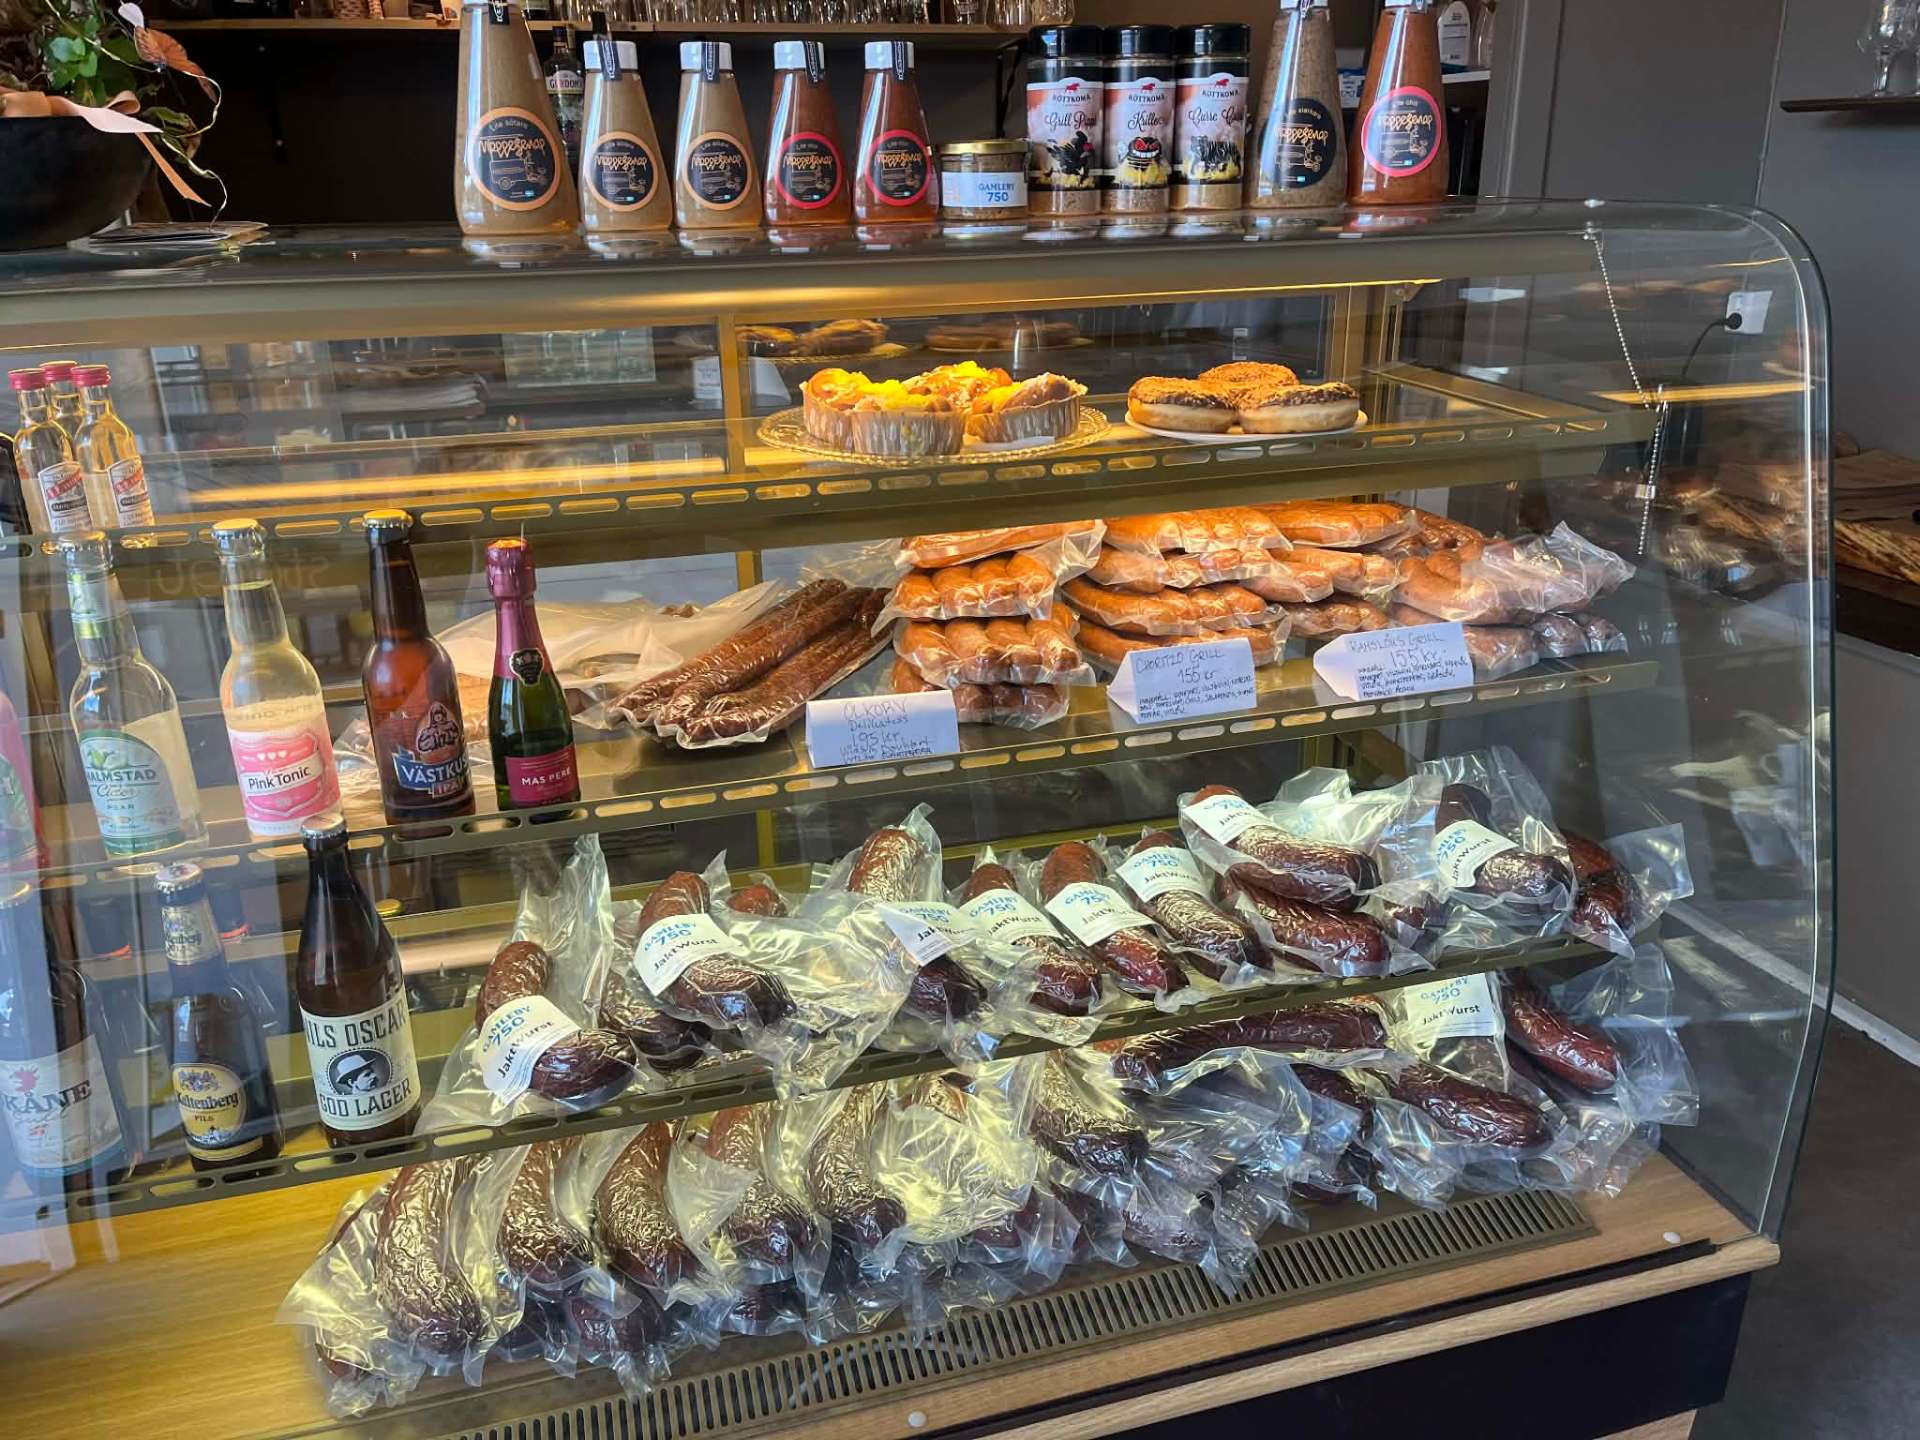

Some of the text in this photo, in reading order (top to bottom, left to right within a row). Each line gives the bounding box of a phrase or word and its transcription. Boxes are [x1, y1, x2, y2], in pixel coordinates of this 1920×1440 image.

[1044, 111, 1072, 132] Grill
[985, 191, 1009, 202] 750
[1390, 645, 1420, 668] 155
[1178, 664, 1200, 684] 155
[248, 766, 311, 790] Pink Tonic
[521, 775, 547, 785] MAS
[1441, 836, 1466, 859] 750
[984, 904, 1016, 916] 750
[658, 929, 692, 946] 750
[654, 939, 719, 970] JaktWurst
[1434, 987, 1460, 1005] 750
[344, 1000, 406, 1047] OSCAR
[491, 1016, 525, 1046] 750
[320, 1078, 412, 1117] GOD LAGER
[194, 1114, 215, 1122] PILS
